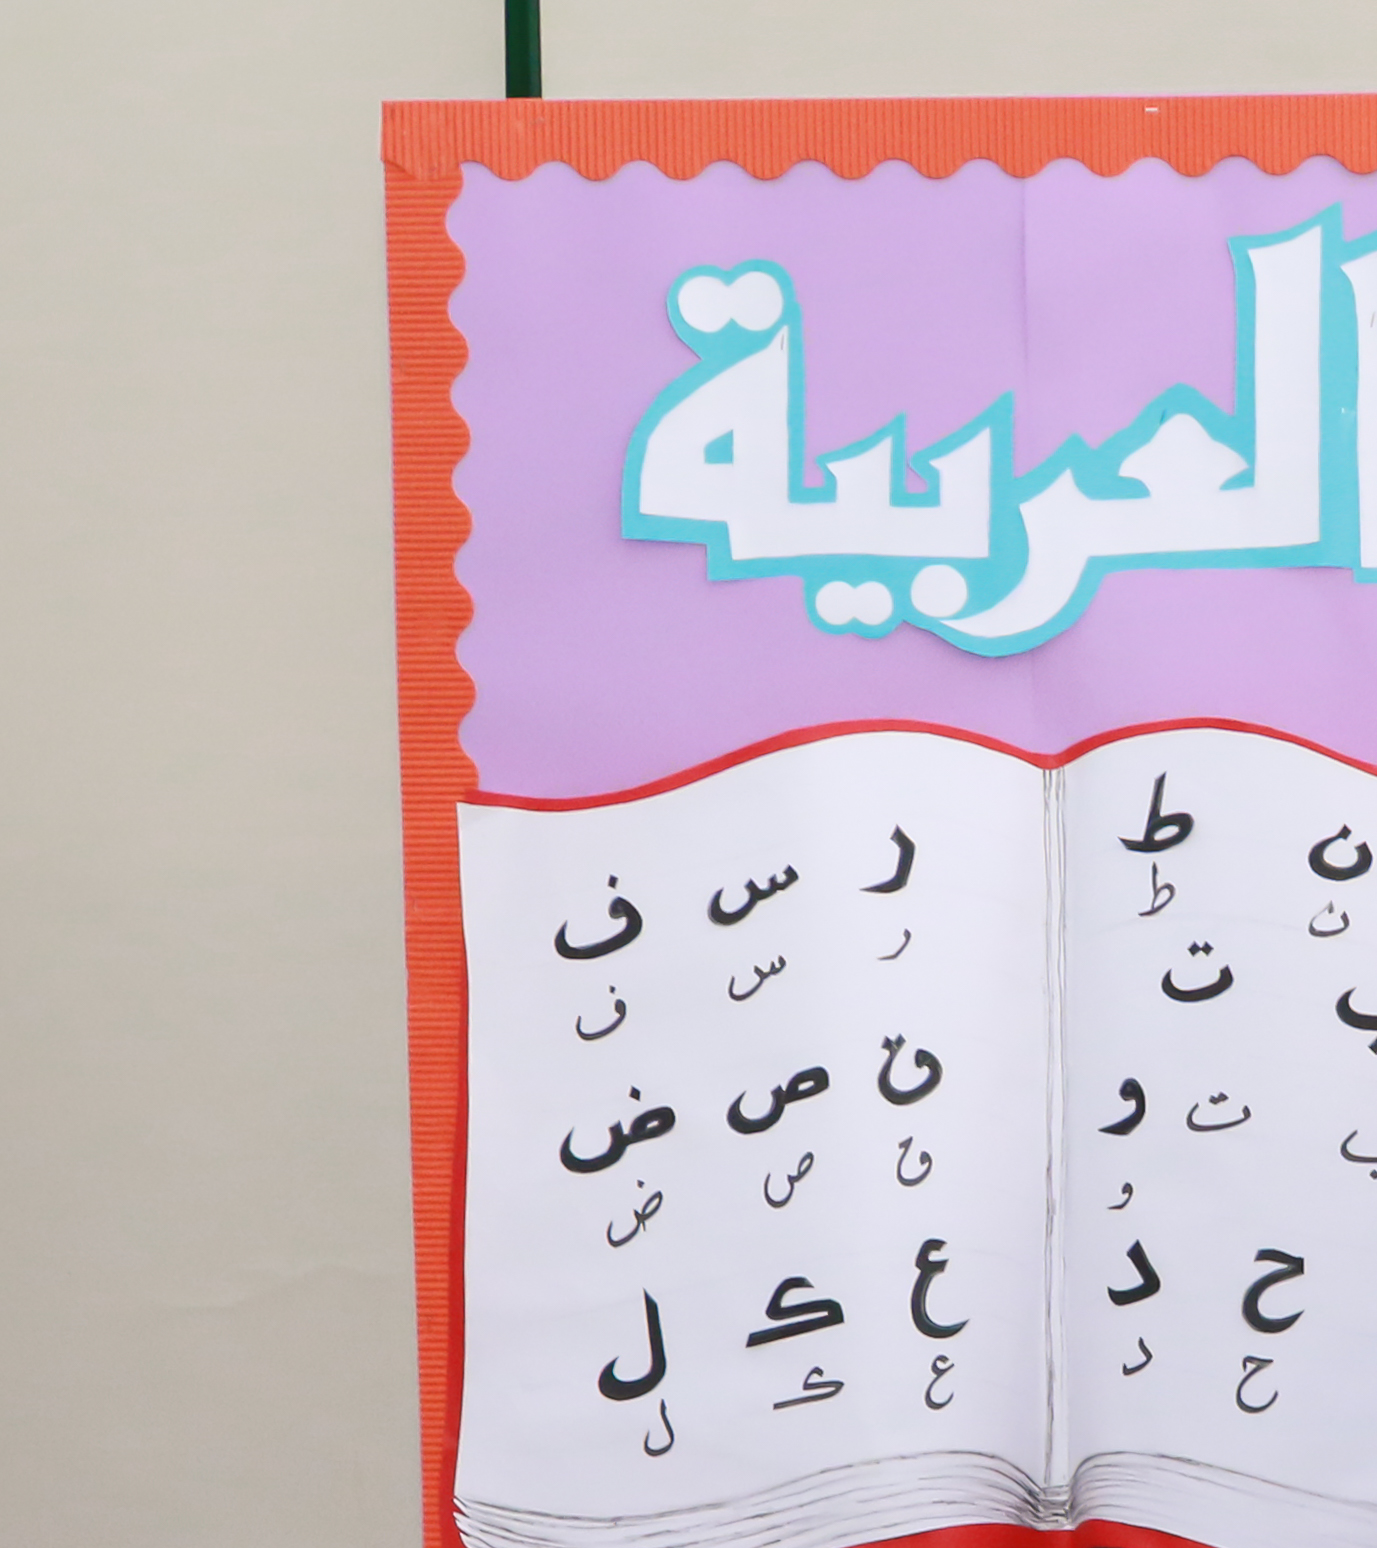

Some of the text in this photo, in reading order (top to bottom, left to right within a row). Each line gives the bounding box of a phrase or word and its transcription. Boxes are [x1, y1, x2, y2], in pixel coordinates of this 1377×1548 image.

[1117, 771, 1374, 882] ن ط
[553, 824, 916, 961] ر س ف
[1137, 861, 1350, 938] ن ط
[575, 928, 912, 1042] ر س ف
[1160, 940, 1235, 1004] ت
[559, 1033, 944, 1175] ق ص ض
[1097, 1077, 1147, 1137] و
[1185, 1091, 1252, 1133] ت
[606, 1135, 933, 1249] ق ص ض
[1107, 1181, 1134, 1211] و
[597, 1238, 970, 1400] ع ك ل
[1106, 1238, 1305, 1335] ح د
[643, 1354, 955, 1458] ع ك ل
[1122, 1336, 1279, 1414] ح د
